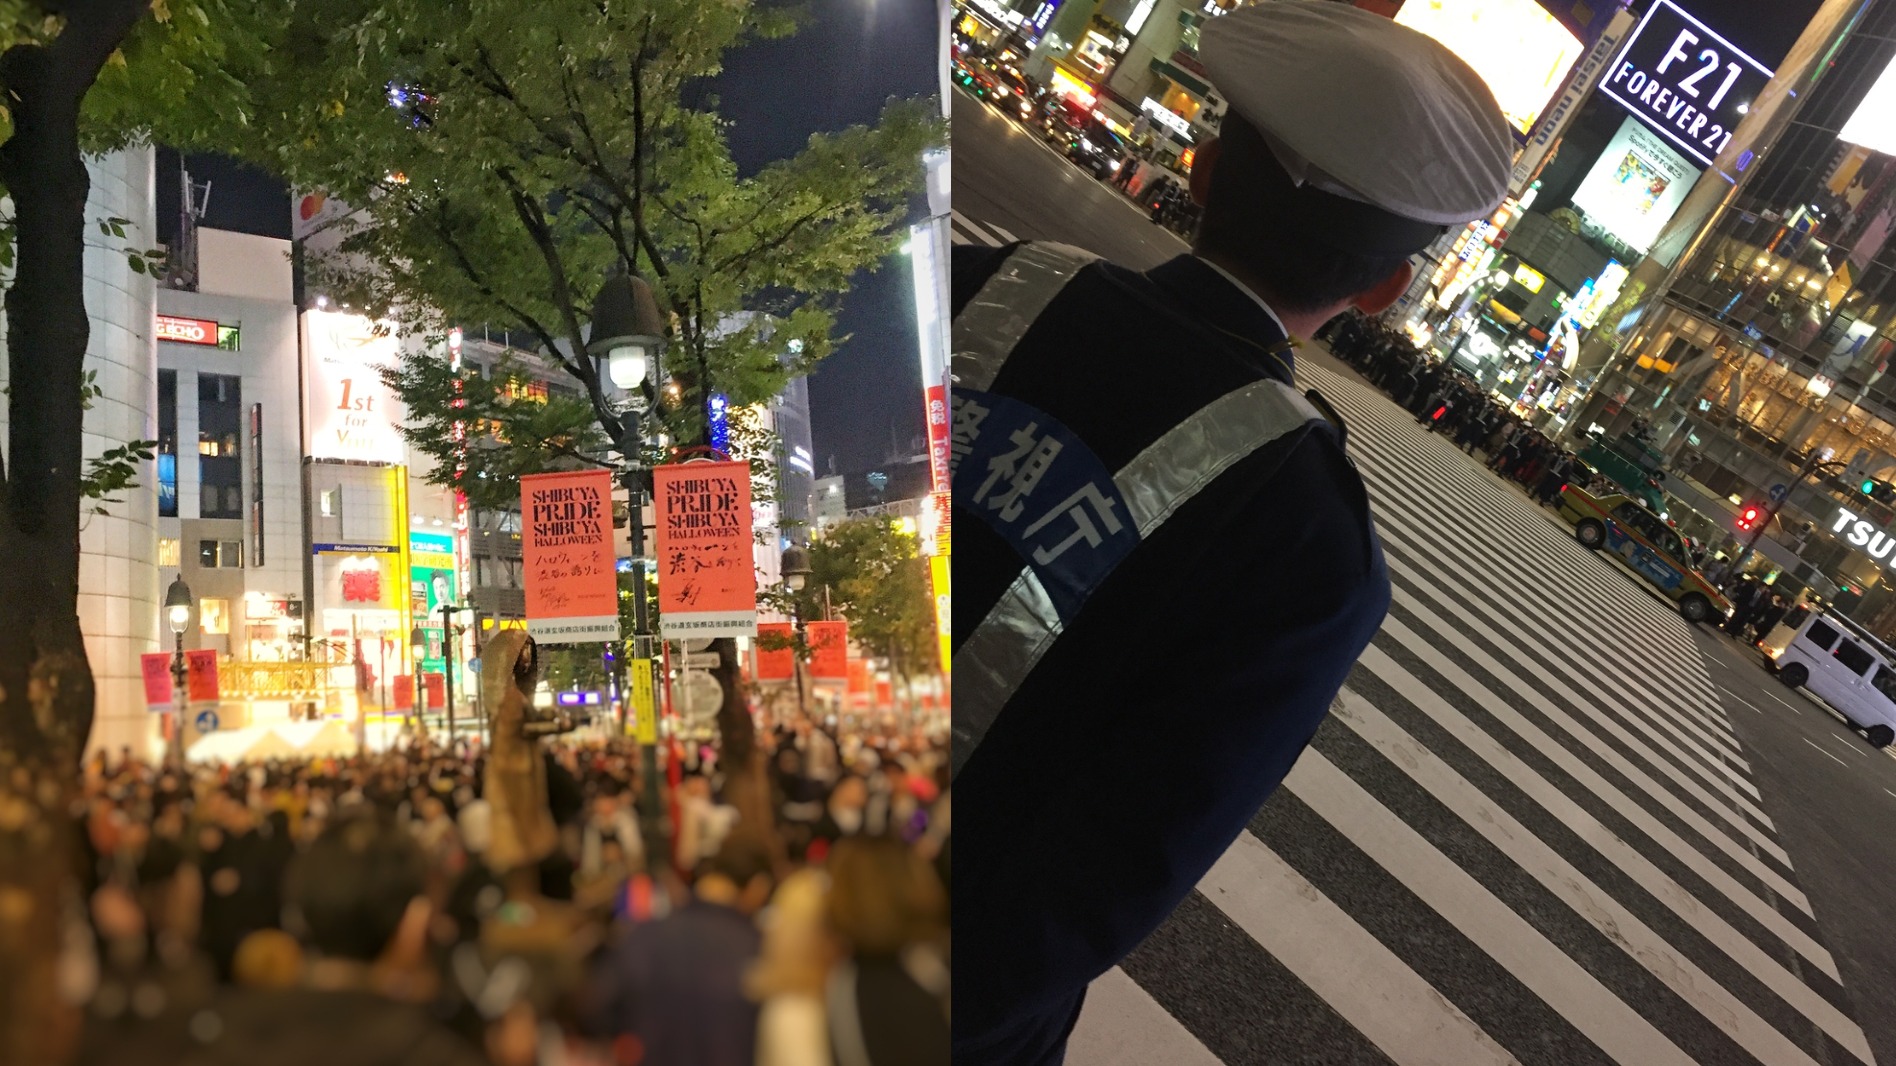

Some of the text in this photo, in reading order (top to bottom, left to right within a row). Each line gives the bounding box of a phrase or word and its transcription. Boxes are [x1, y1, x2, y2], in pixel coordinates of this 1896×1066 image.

[1656, 28, 1742, 111] F21
[1613, 60, 1732, 155] FOREVER 21
[1534, 95, 1573, 147] neon
[166, 325, 205, 340] ECHO
[336, 378, 374, 412] 1st
[345, 414, 368, 427] for
[532, 486, 599, 504] SHIBUYA
[666, 478, 737, 495] SHIBUYA
[533, 500, 602, 523] PRIDE
[667, 492, 739, 514] PRIDE
[534, 520, 602, 537] SHIBUYA
[667, 512, 739, 529] SHIBUYA
[534, 534, 603, 548] HALLOWEEN
[668, 527, 740, 540] HALLOWEEN
